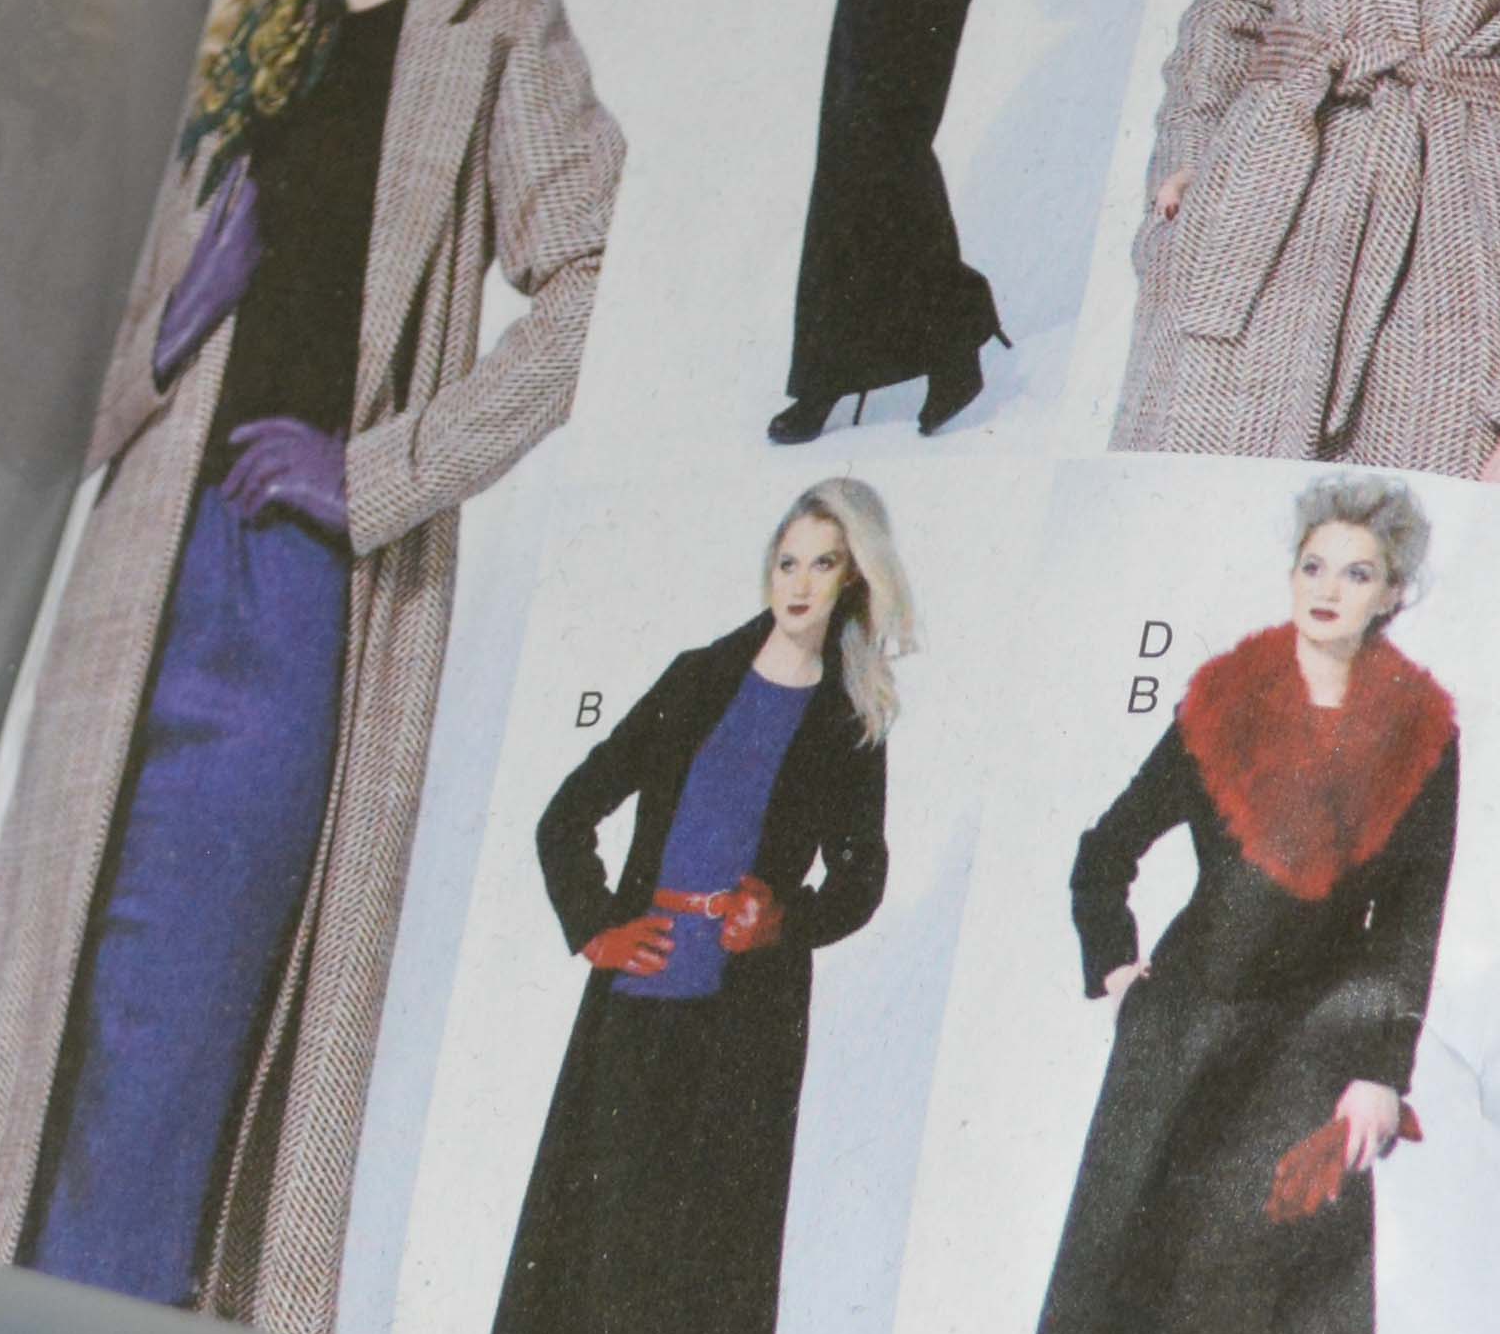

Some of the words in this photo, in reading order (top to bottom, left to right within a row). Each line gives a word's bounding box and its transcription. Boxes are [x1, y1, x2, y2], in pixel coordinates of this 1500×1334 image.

[1137, 620, 1174, 660] D
[574, 691, 604, 728] B
[1126, 676, 1160, 715] B
